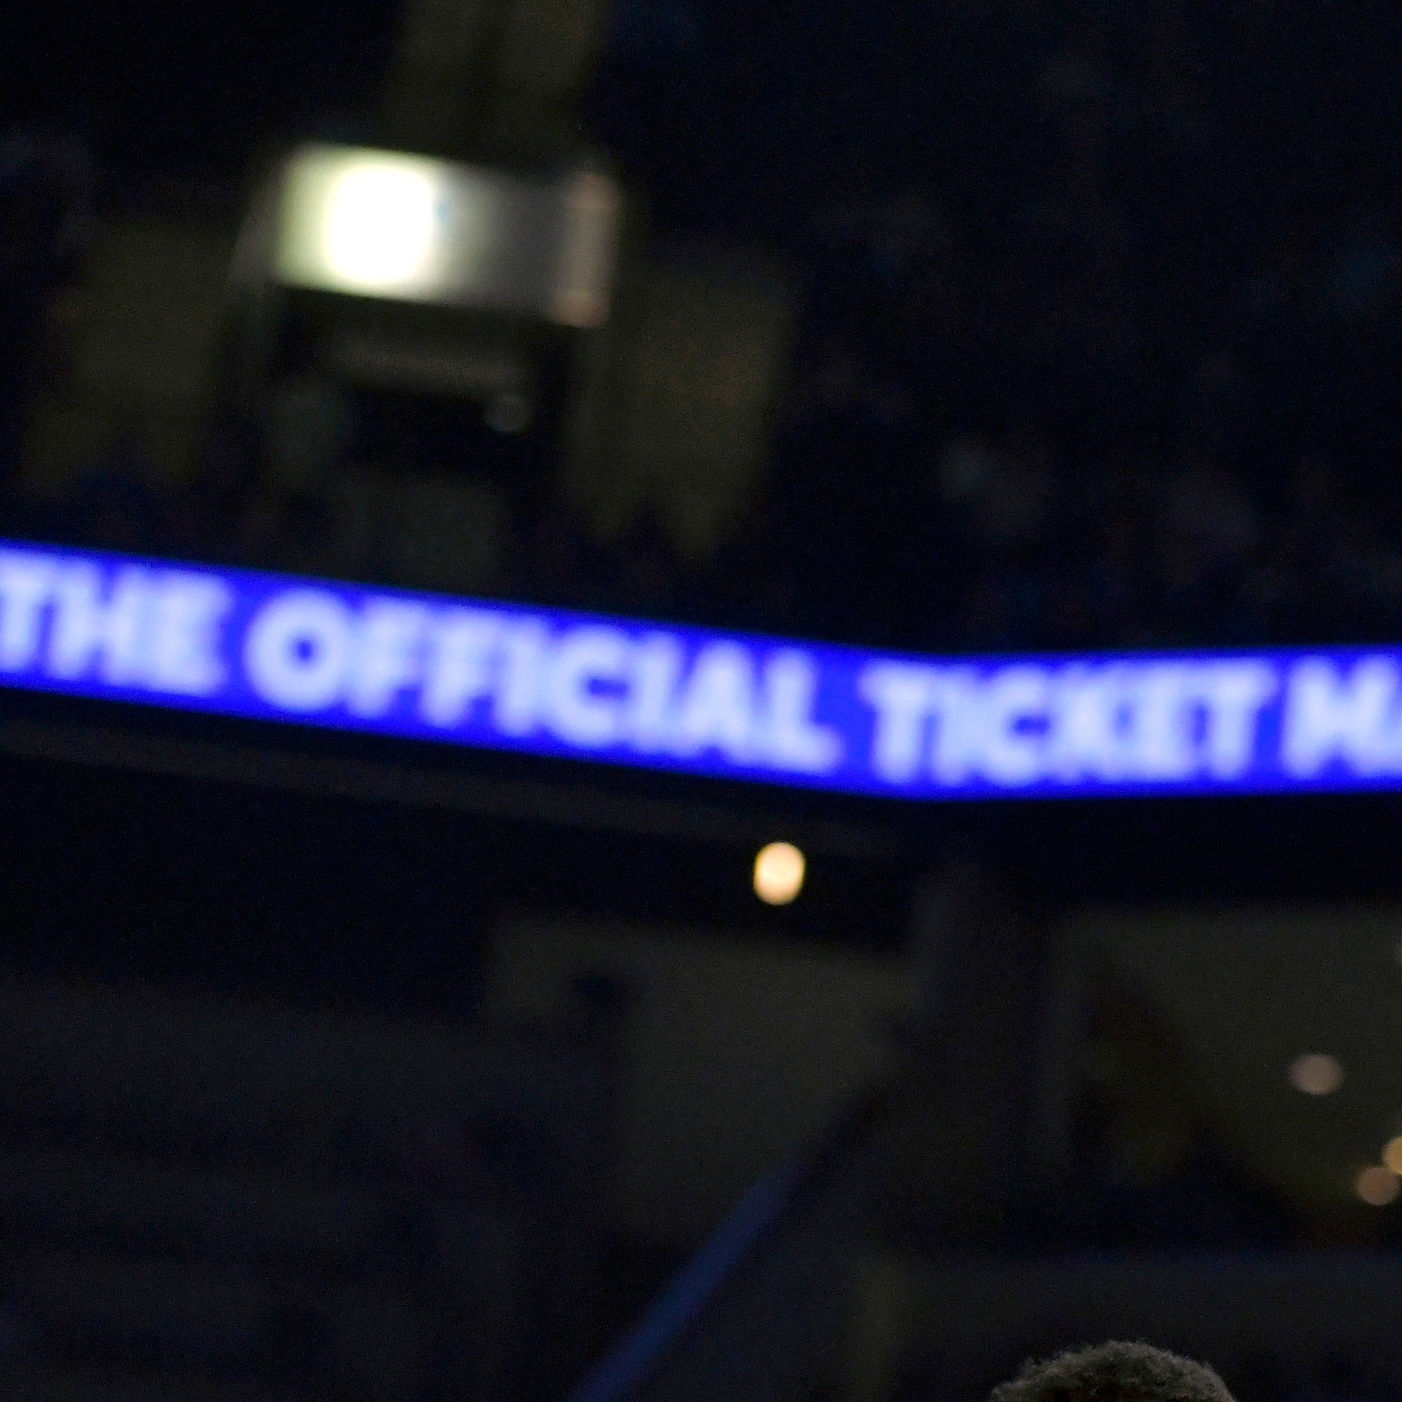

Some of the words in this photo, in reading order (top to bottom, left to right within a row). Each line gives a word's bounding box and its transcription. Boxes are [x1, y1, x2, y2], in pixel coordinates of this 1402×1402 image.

[0, 549, 230, 695] THE
[244, 588, 840, 775] OFFICIAL
[858, 658, 1275, 785] TICKET
